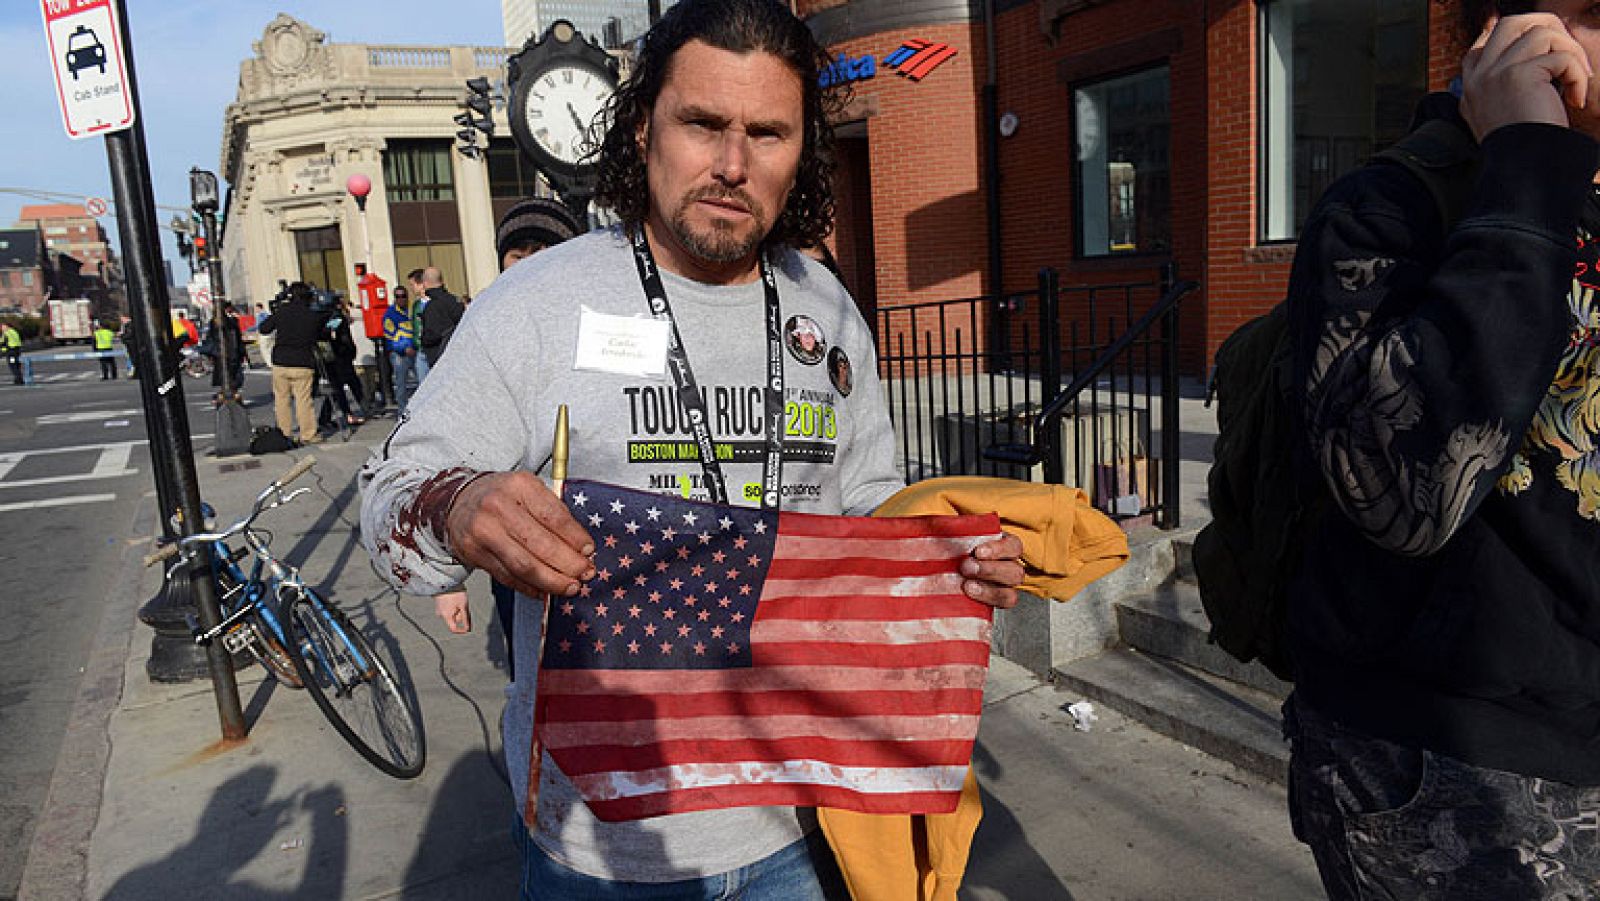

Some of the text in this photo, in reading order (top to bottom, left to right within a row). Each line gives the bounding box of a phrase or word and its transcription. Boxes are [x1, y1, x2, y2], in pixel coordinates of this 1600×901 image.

[74, 82, 119, 102] Cab Stand
[623, 386, 708, 435] TOUG
[716, 386, 770, 436] RUC
[785, 401, 837, 439] 2013
[630, 443, 676, 460] BOSTON
